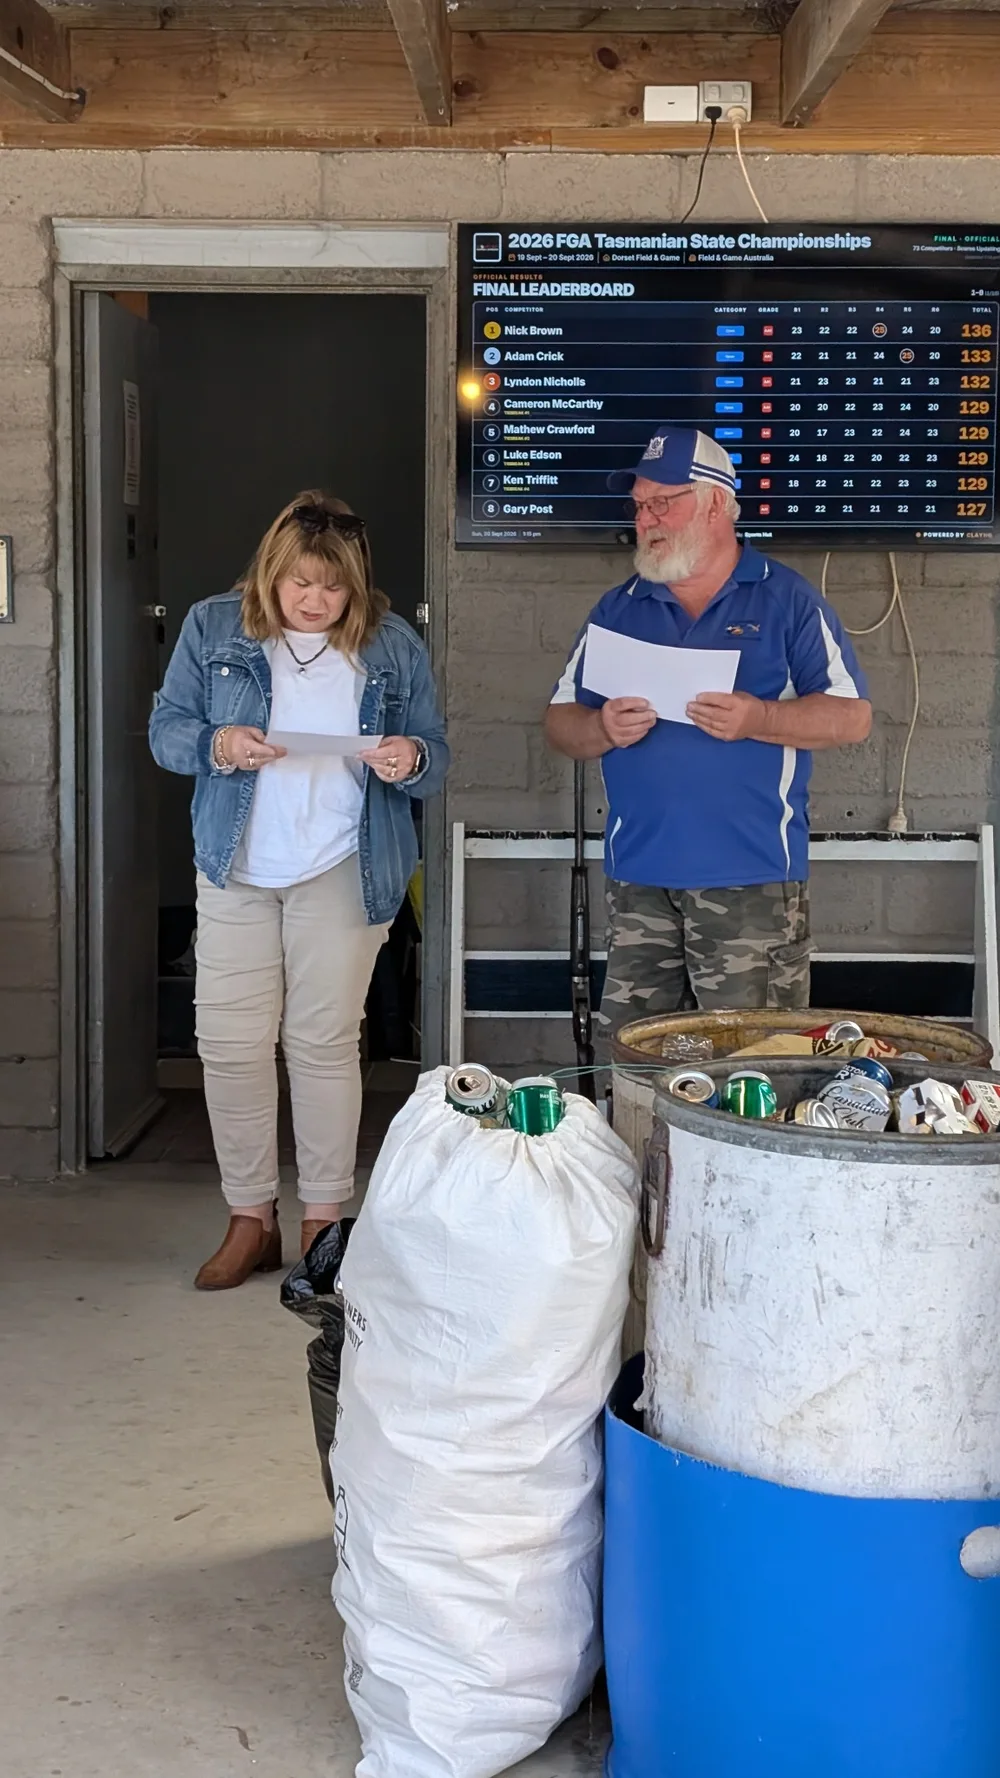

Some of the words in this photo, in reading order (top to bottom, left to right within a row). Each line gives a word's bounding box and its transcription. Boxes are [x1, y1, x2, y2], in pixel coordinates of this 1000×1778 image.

[509, 233, 554, 248] 2026
[556, 234, 592, 248] FGA
[594, 233, 687, 248] Tasmanian
[690, 234, 735, 248] State
[738, 233, 871, 251] Championships
[526, 254, 542, 262] Sept
[559, 254, 575, 262] Sept
[474, 283, 519, 296] FINAL
[521, 283, 634, 296] LEADERBOARD
[505, 326, 528, 335] Nick
[530, 326, 562, 335] Brown
[962, 324, 991, 337] 136
[504, 352, 534, 361] Adam
[536, 351, 564, 360] Crick
[961, 350, 991, 362] 133
[504, 377, 542, 387] Lyndon
[544, 377, 585, 386] Nicholls
[961, 376, 990, 388] 132
[488, 403, 495, 411] 4
[504, 399, 550, 408] Cameron
[552, 399, 603, 410] McCarthy
[960, 401, 989, 414] 129
[504, 425, 545, 433] Mathew
[547, 425, 594, 434] Crawford
[959, 427, 989, 439] 129
[488, 454, 495, 462] 6
[504, 450, 528, 459] Luke
[530, 450, 562, 459] Edson
[959, 452, 988, 465] 129
[504, 475, 523, 484] Ken
[525, 475, 558, 484] Triffitt
[958, 478, 987, 490] 129
[487, 505, 494, 513] 8
[503, 504, 528, 514] Gary
[530, 504, 553, 513] Post
[957, 503, 986, 516] 127
[823, 1086, 891, 1117] Canadian
